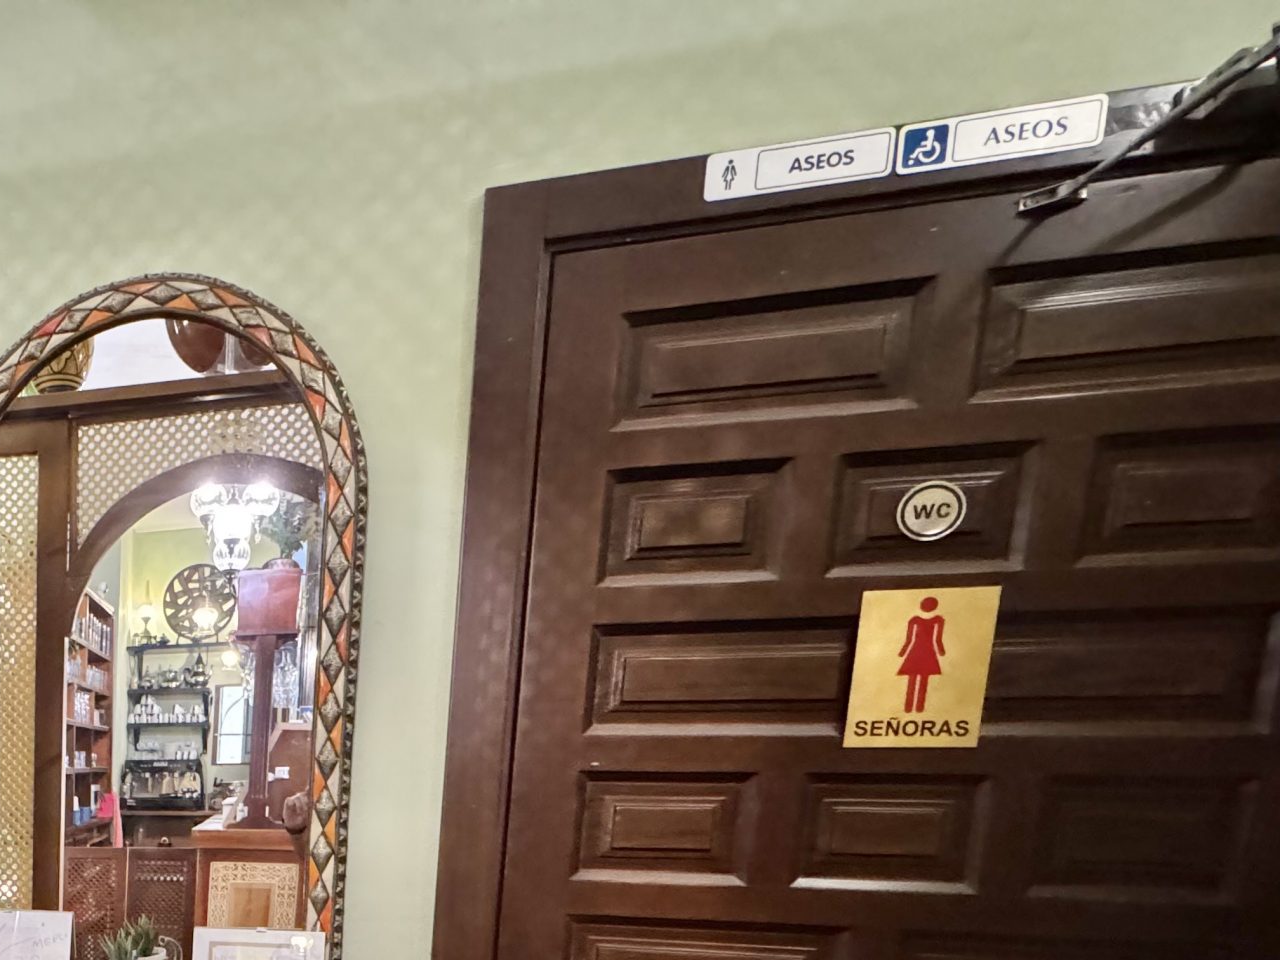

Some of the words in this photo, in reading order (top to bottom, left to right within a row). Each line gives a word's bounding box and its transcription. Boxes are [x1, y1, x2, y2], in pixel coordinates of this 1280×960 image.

[984, 116, 1069, 146] ASEOS
[788, 149, 855, 174] ASEOS
[912, 502, 952, 520] WC
[853, 717, 970, 737] SEÑORAS
